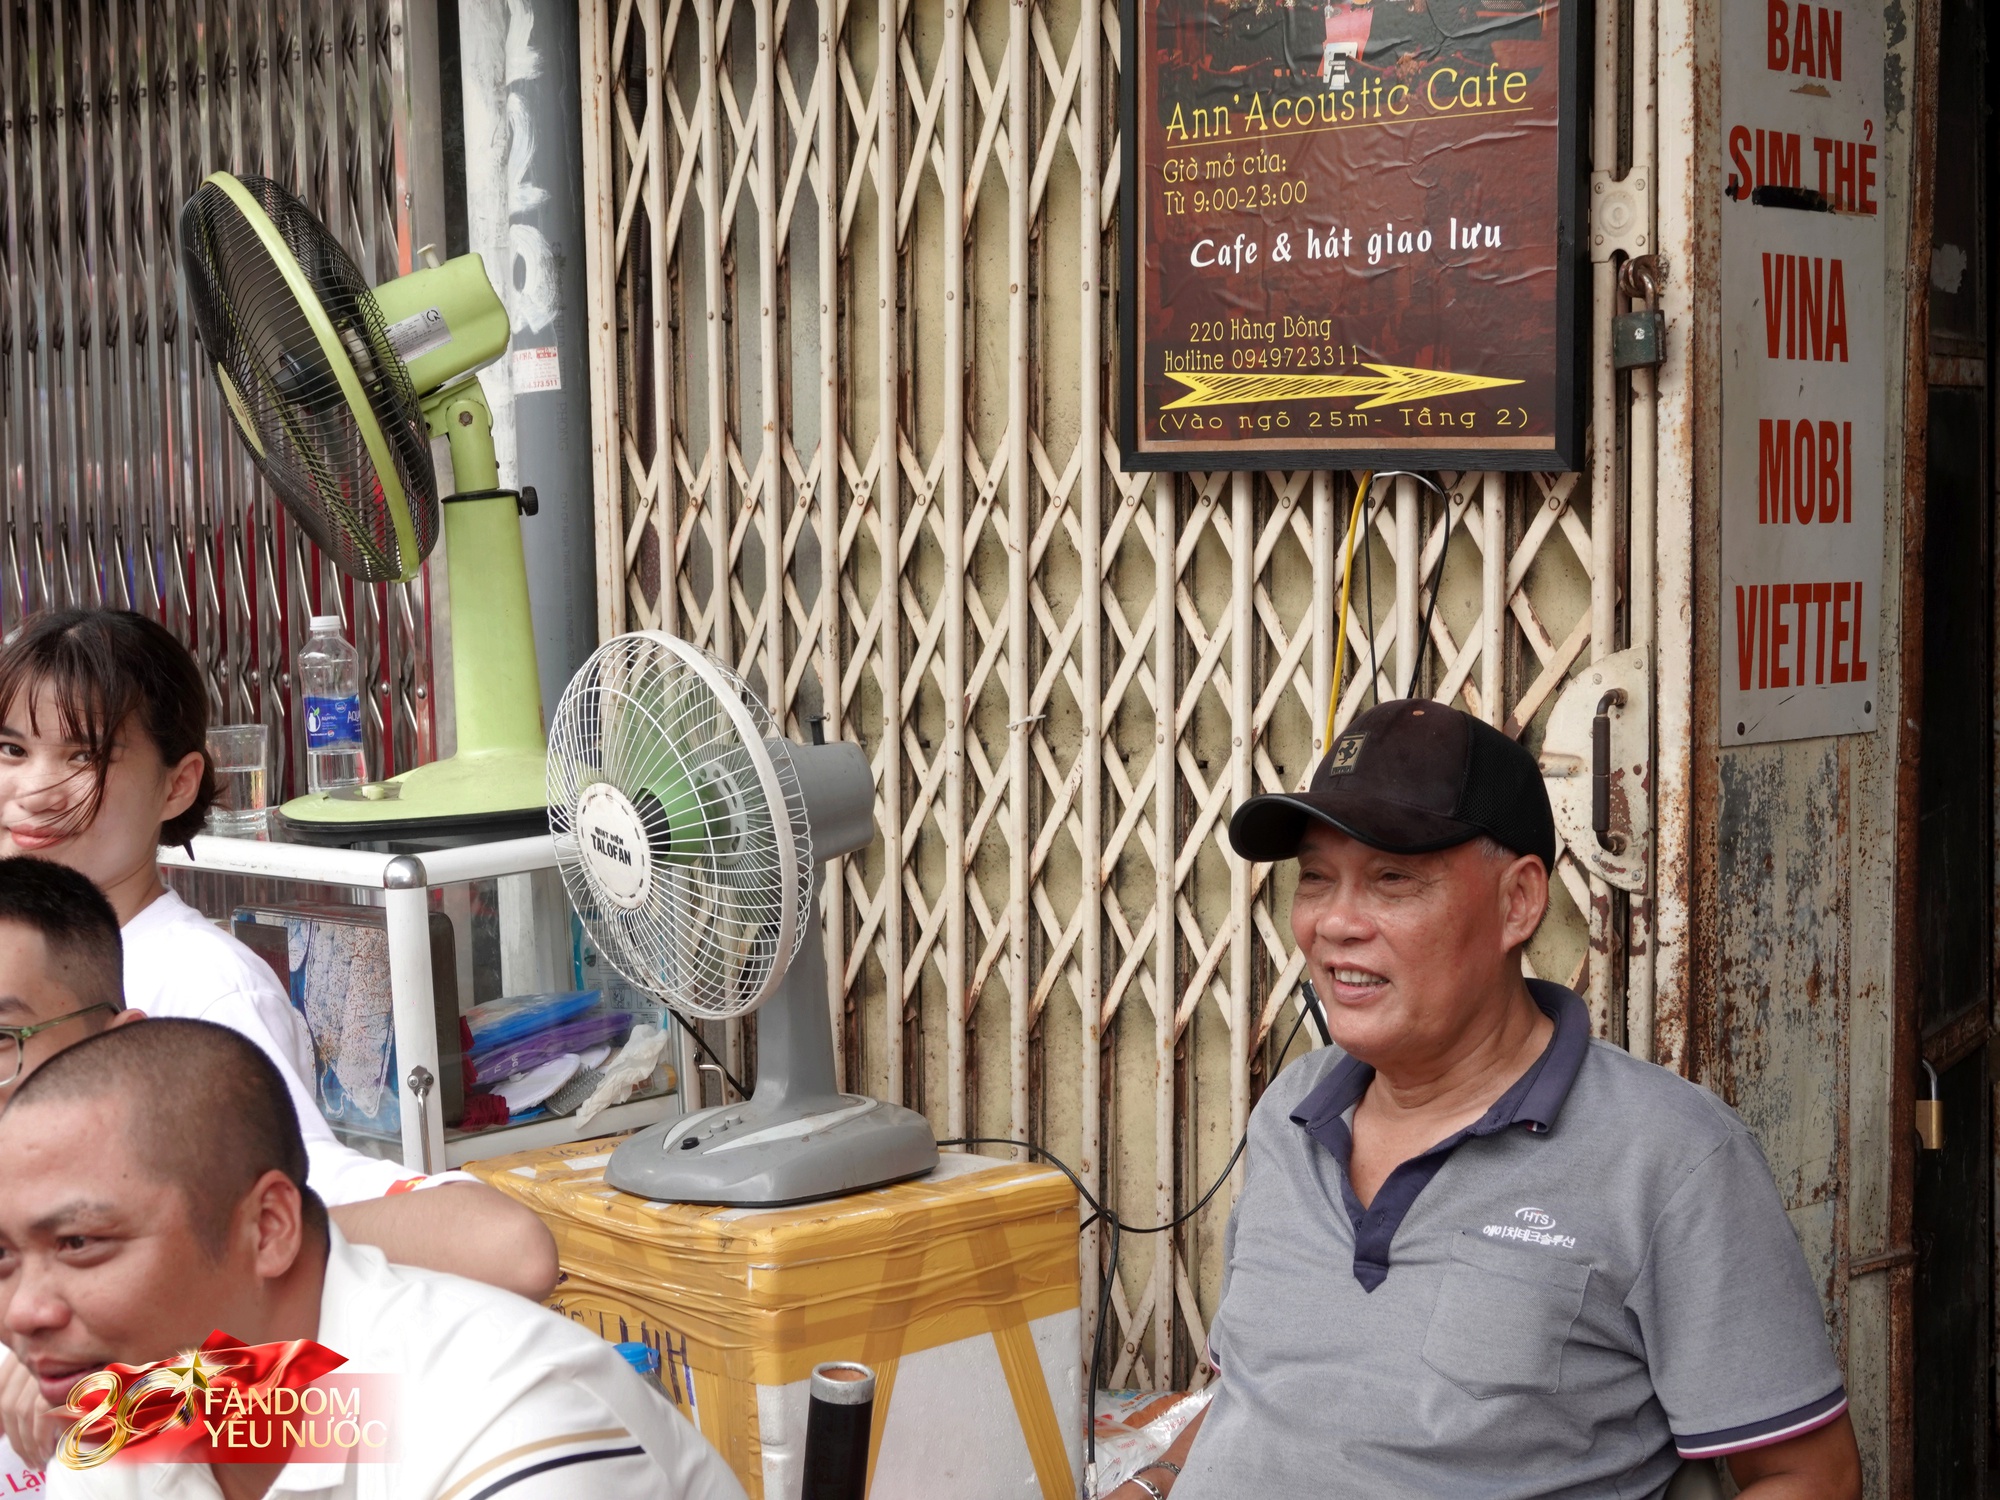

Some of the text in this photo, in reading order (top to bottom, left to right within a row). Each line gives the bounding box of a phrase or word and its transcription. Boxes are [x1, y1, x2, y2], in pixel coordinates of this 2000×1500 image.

[1427, 63, 1527, 110] Cafe
[1163, 150, 1286, 184] Giờ mở cửa:
[1729, 119, 1877, 215] SIM THẺ
[1164, 181, 1307, 215] Từ 9:00-23:00
[1190, 218, 1502, 273] Cafe & hát giao lưu
[1762, 253, 1848, 363] VINA
[1190, 316, 1332, 344] 220 Hàng Bông
[1164, 345, 1359, 372] Hotline 0949723311
[1159, 411, 1222, 433] (Vào
[1239, 409, 1292, 430] ngõ
[1497, 408, 1528, 428] 2)
[1759, 418, 1852, 525] MOBI
[1735, 581, 1867, 690] VIETTEL
[590, 833, 632, 866] TALOFAN
[1523, 1211, 1549, 1225] HTS
